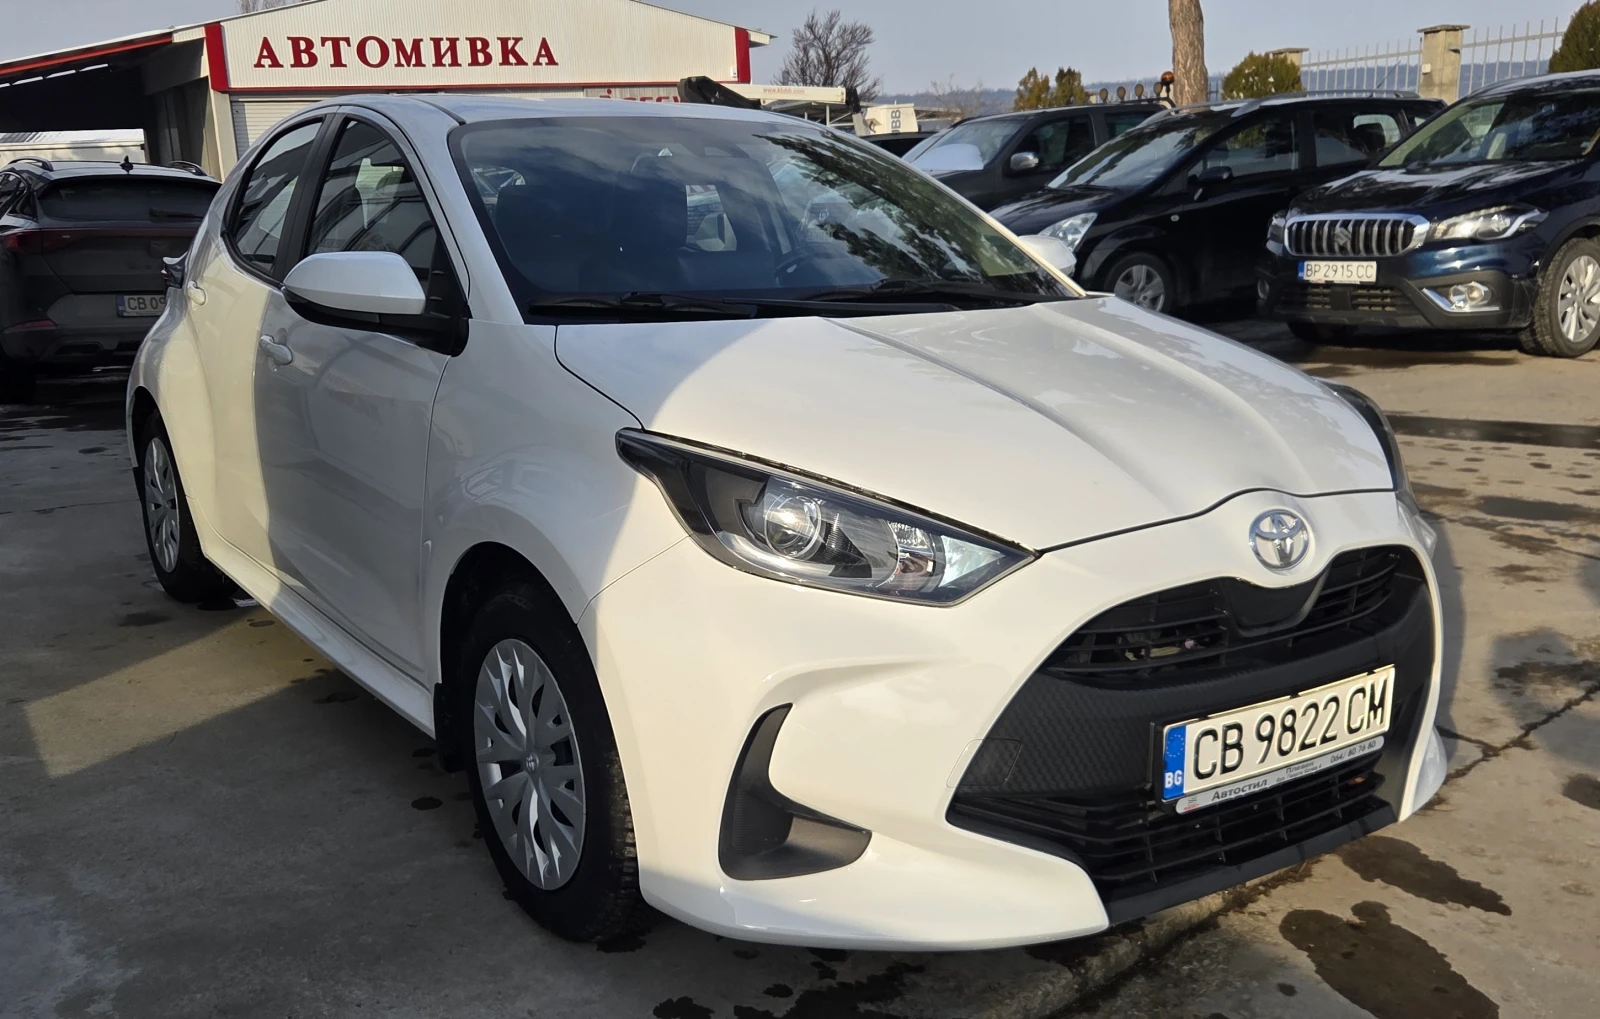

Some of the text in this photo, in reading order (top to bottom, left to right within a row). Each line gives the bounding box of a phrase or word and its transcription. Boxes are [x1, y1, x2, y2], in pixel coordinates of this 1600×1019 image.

[253, 35, 559, 69] АВТОМИВКА
[1323, 264, 1353, 279] 2915
[1356, 264, 1374, 279] CC
[1193, 679, 1388, 780] CB 9822 CM
[1164, 770, 1183, 788] BG
[1211, 779, 1268, 801] Автостил
